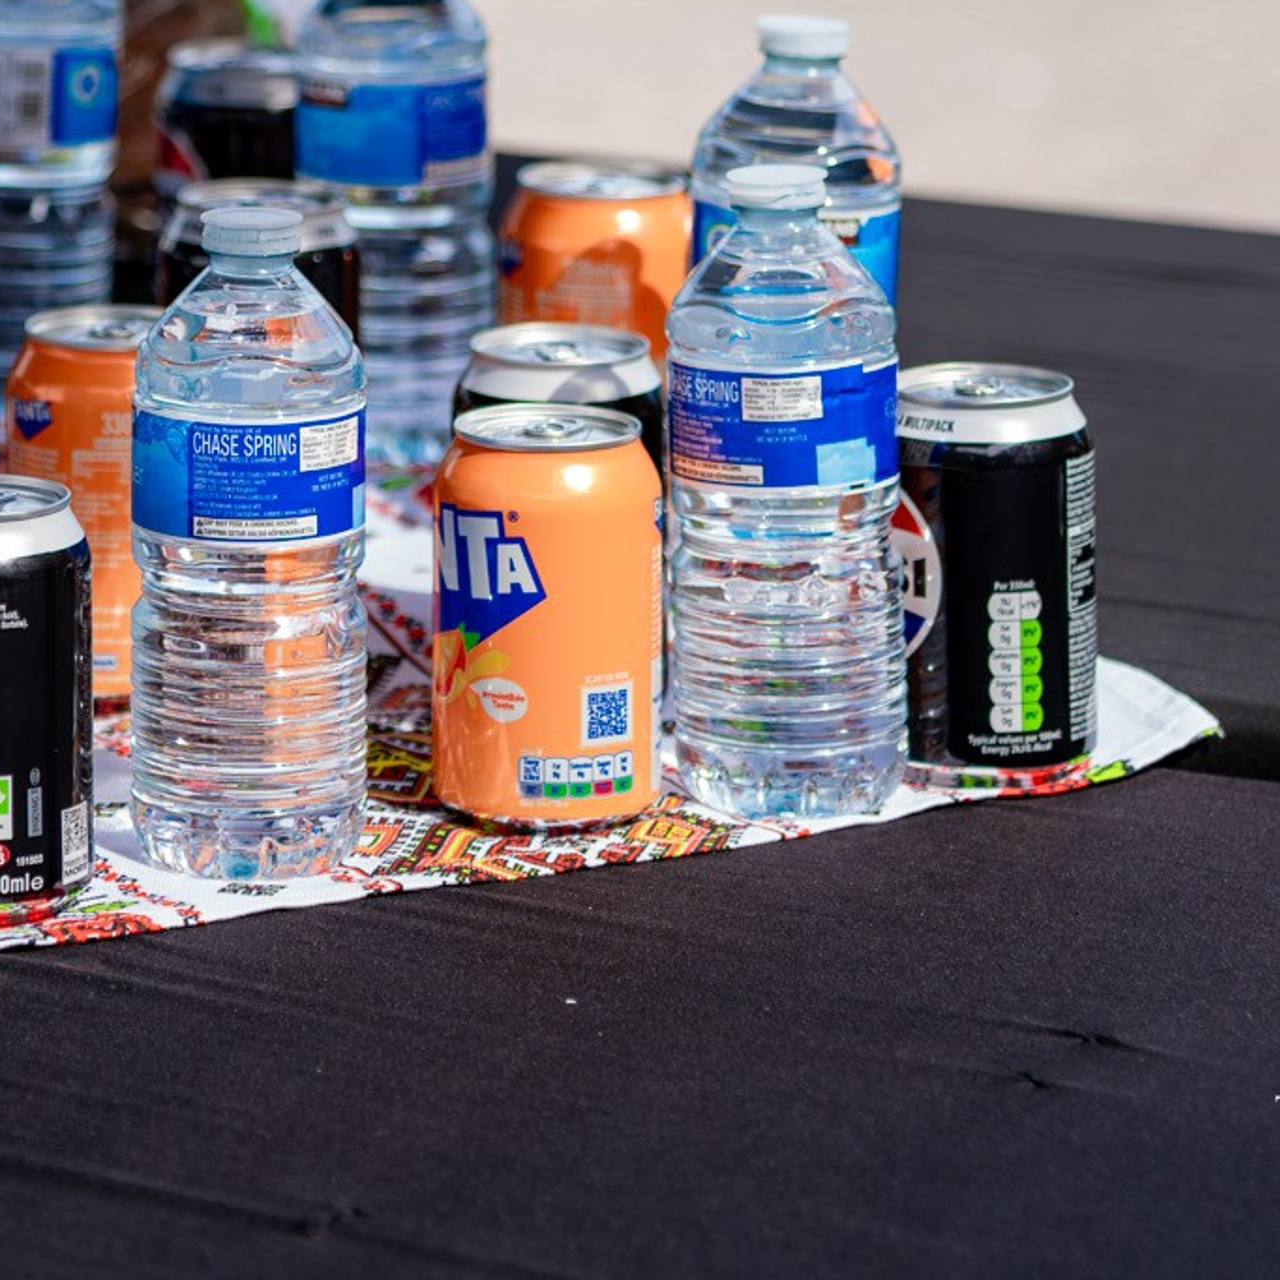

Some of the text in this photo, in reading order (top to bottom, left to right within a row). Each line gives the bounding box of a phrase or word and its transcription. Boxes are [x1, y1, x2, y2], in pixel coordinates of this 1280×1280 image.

[695, 376, 740, 403] SPRING
[192, 431, 239, 456] CHASE
[243, 432, 297, 457] SPRING
[993, 580, 1008, 592] Per
[492, 699, 515, 711] Taste
[968, 732, 997, 747] Typical
[997, 734, 1023, 745] values
[1025, 734, 1038, 745] per
[980, 744, 1010, 757] Energy
